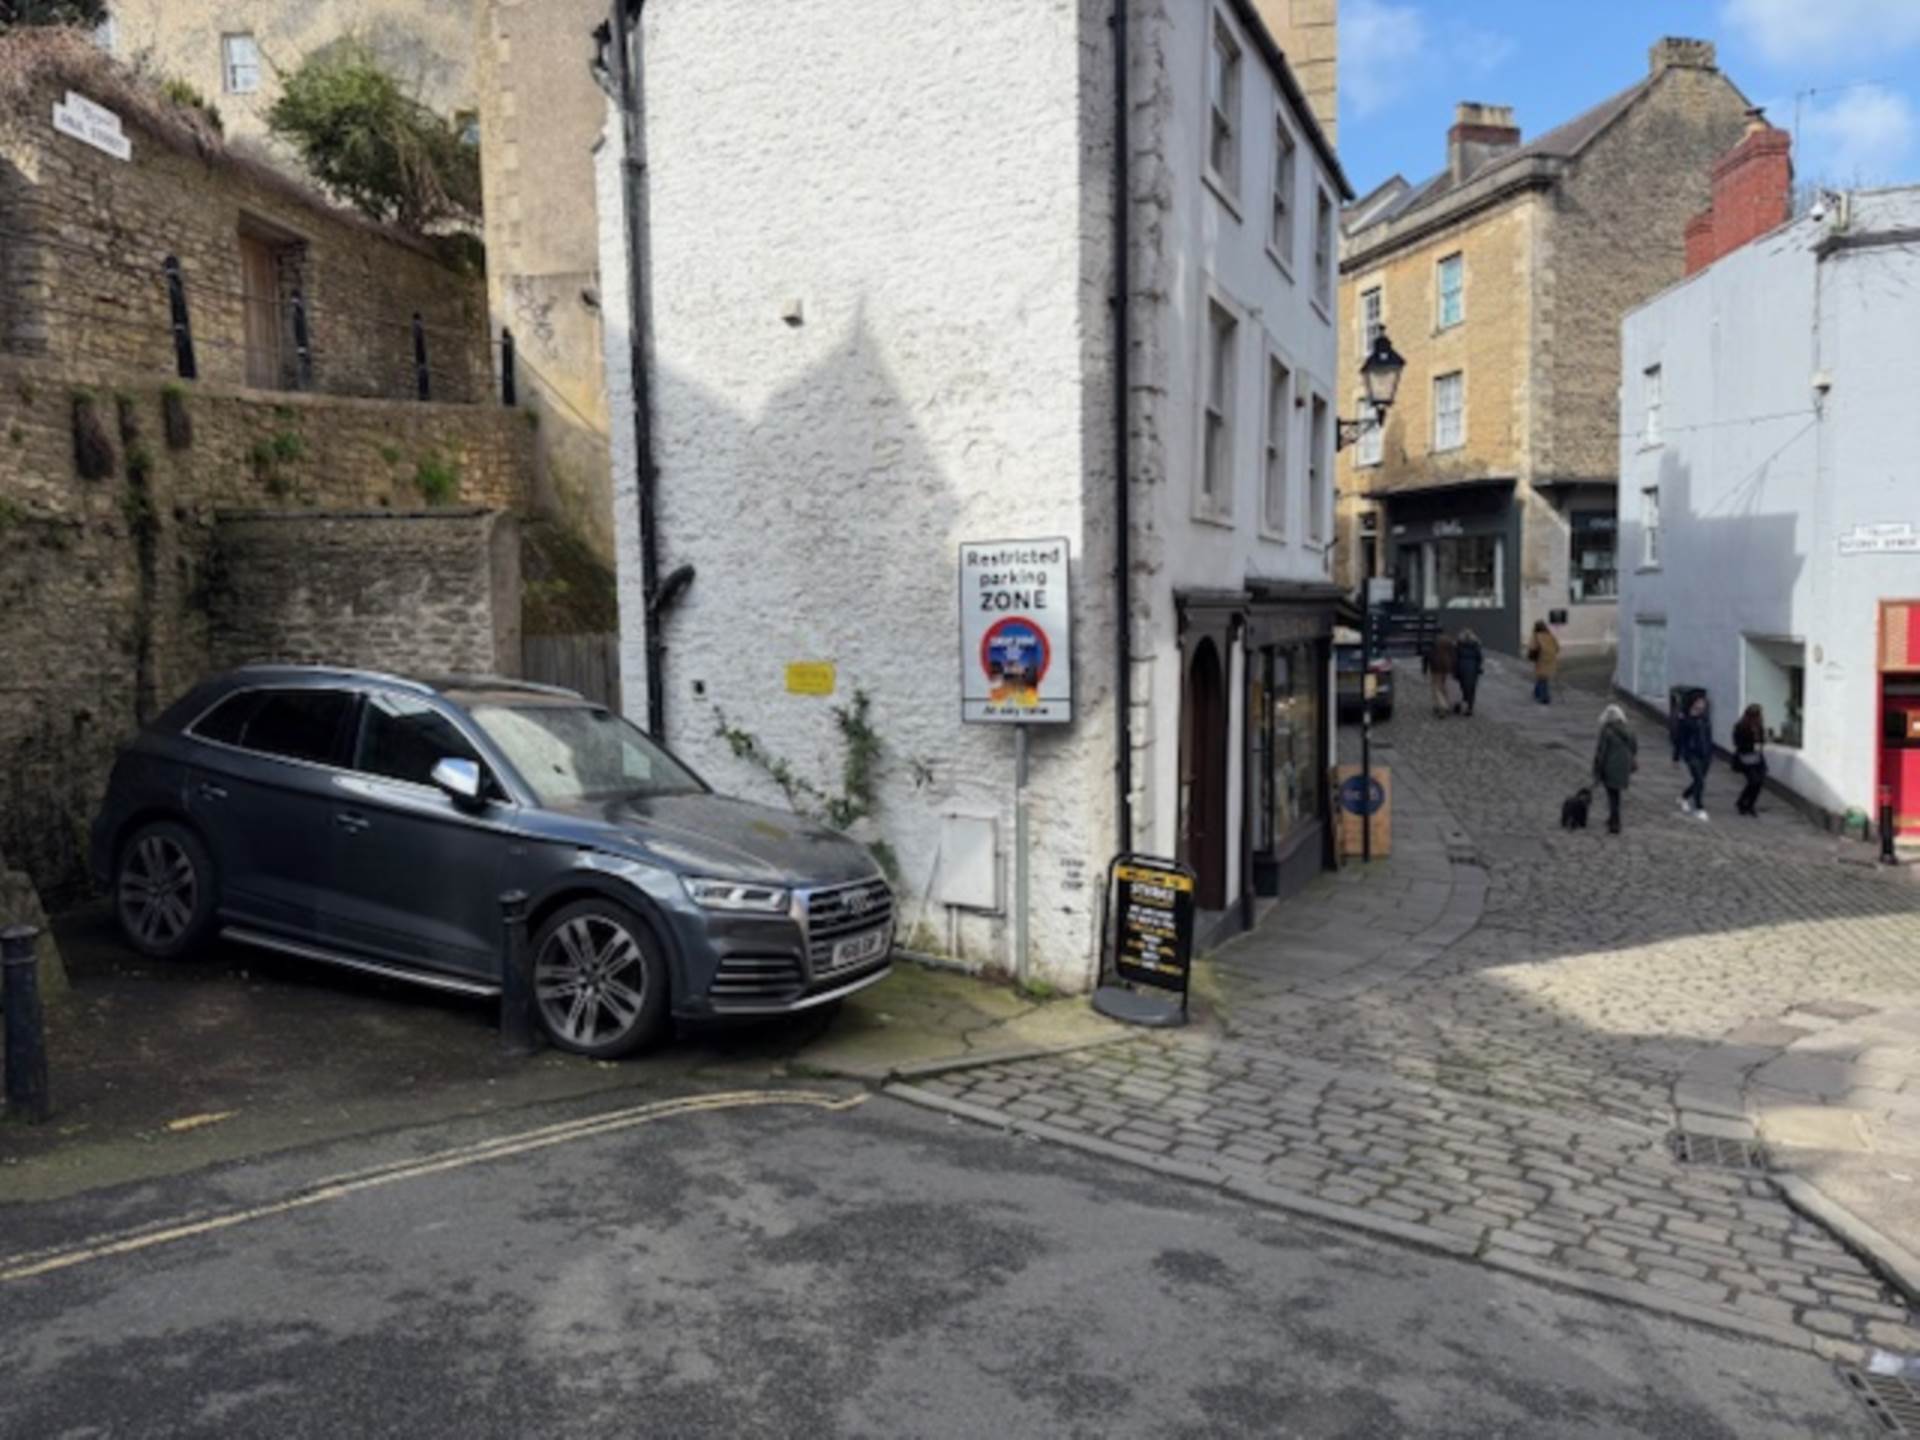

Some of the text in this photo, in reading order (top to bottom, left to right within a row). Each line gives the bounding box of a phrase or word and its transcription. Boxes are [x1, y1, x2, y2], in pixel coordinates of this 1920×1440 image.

[967, 549, 1060, 567] Restricted
[979, 569, 1047, 588] parking
[980, 590, 1047, 611] ZONE
